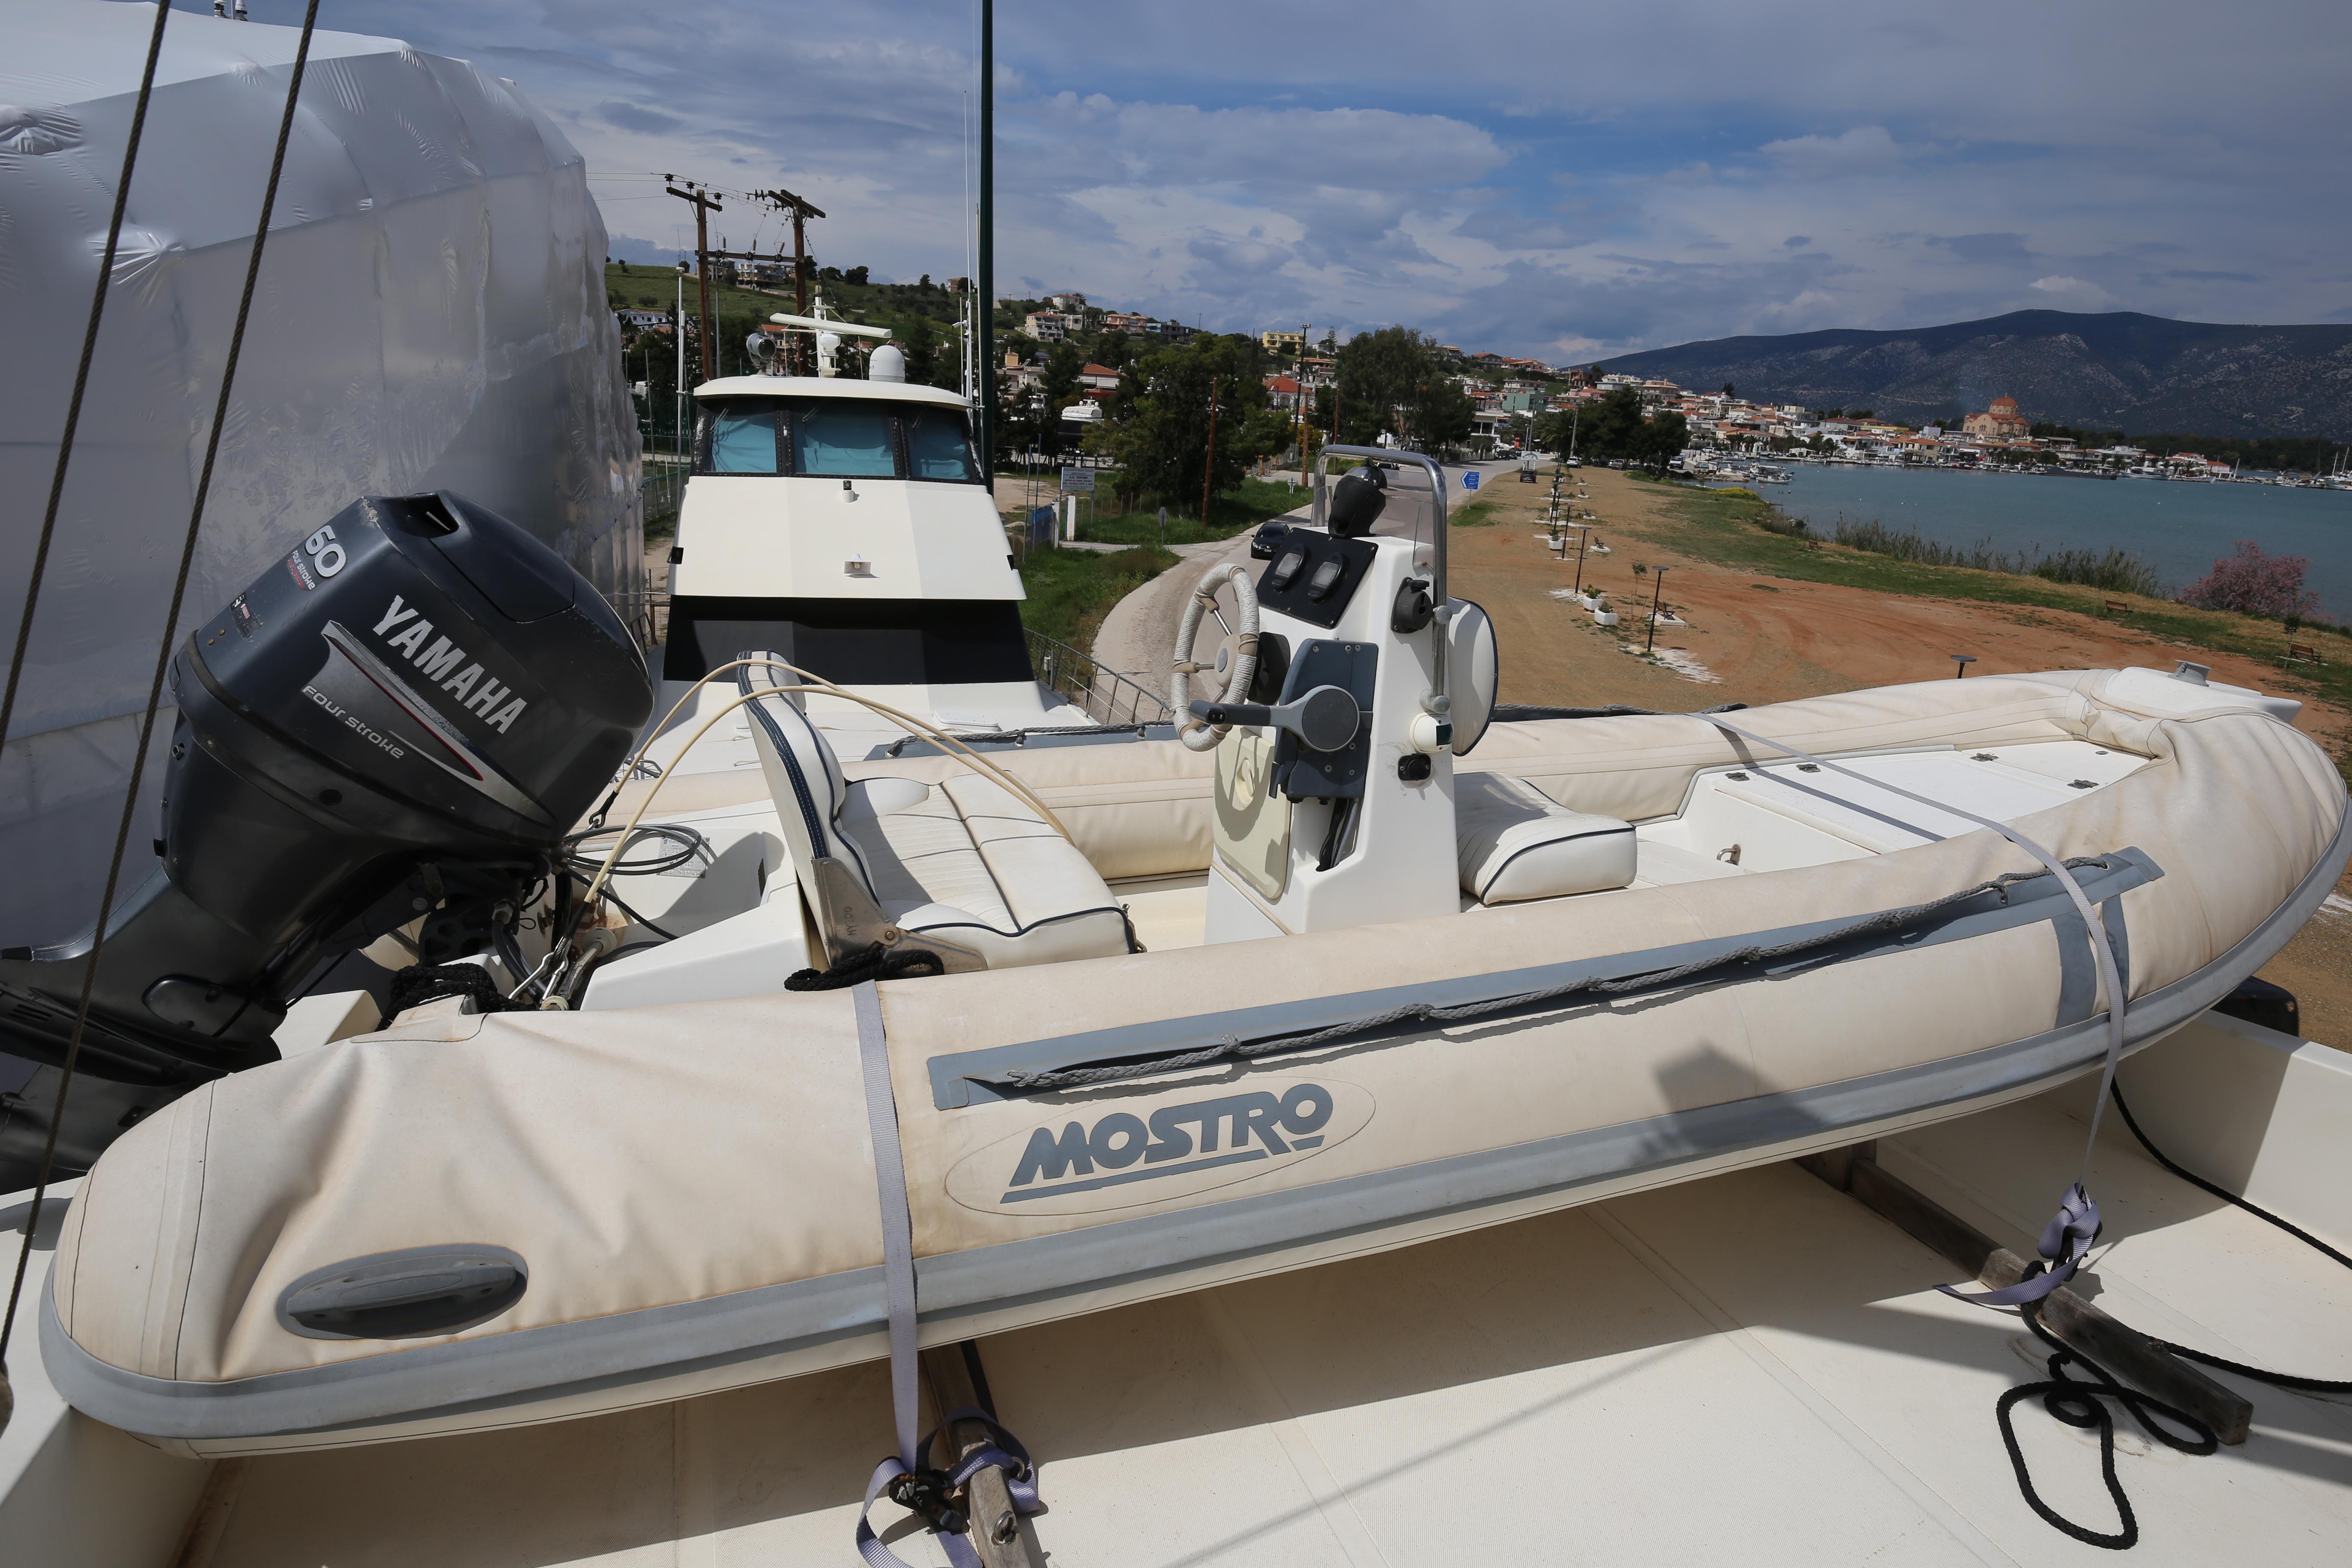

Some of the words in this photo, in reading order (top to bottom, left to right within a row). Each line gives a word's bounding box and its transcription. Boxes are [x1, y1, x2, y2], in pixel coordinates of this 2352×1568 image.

[305, 525, 346, 578] 60
[373, 595, 527, 734] YAMAHA
[844, 906, 858, 936] OCEAN
[1009, 1084, 1333, 1186] MOSTRO
